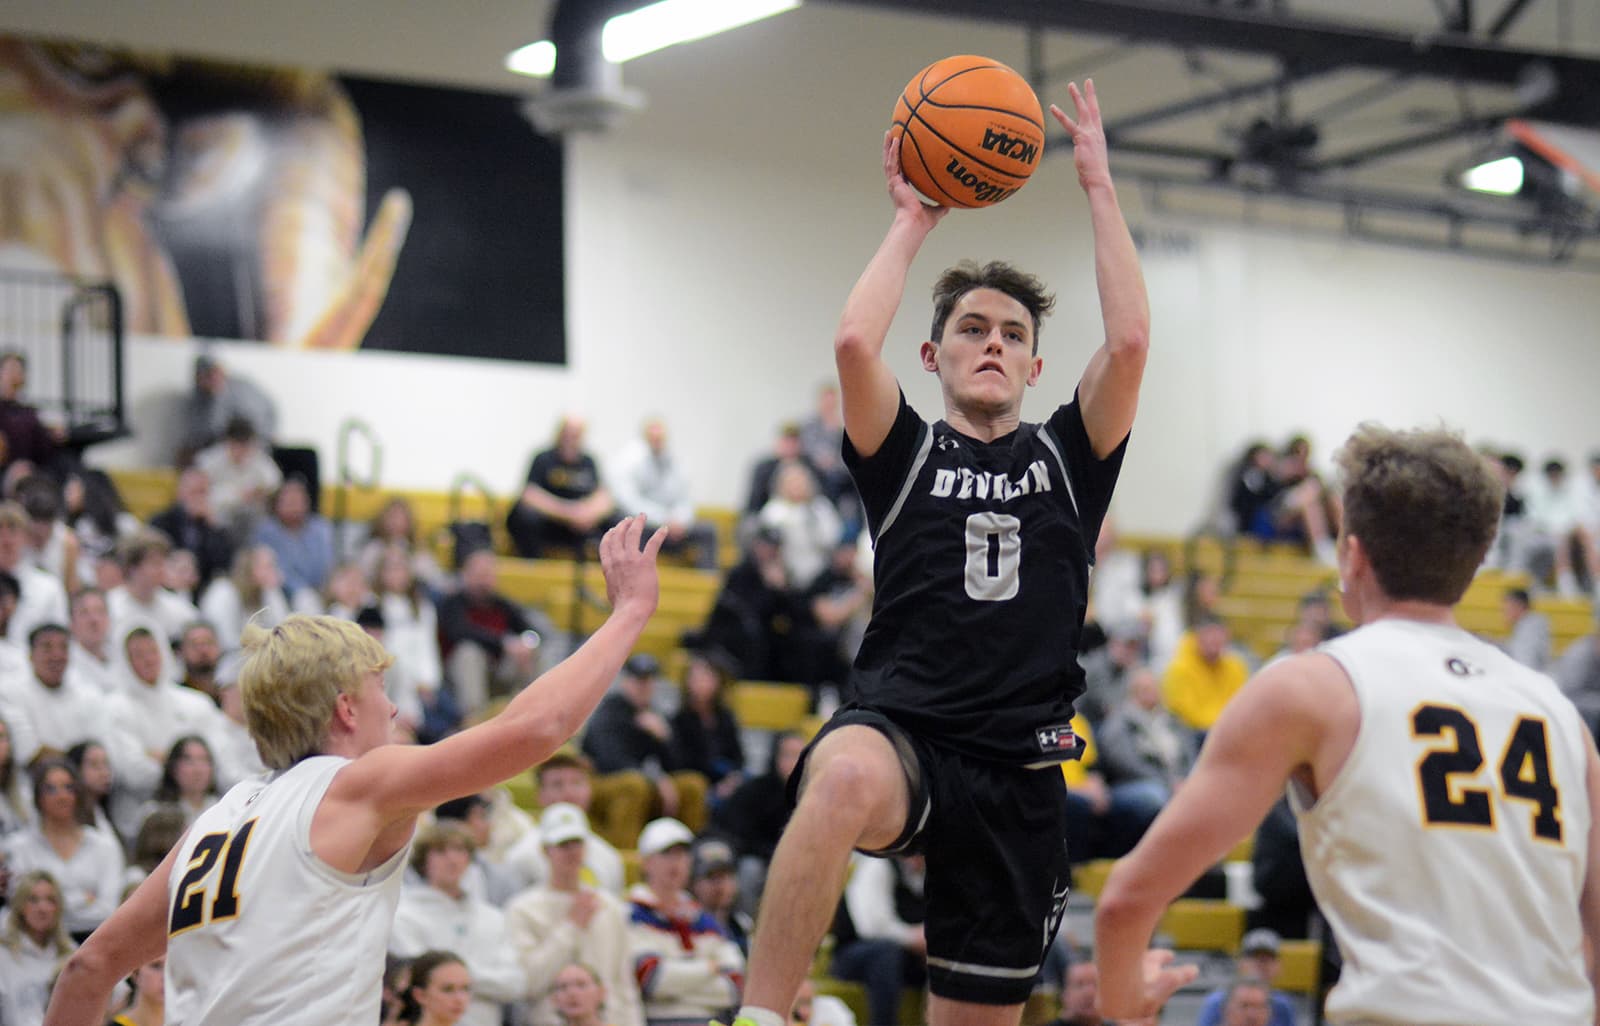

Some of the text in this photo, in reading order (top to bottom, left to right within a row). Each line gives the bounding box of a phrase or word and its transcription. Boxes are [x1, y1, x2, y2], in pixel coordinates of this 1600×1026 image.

[946, 158, 1022, 201] ilson
[982, 128, 1038, 165] NCAA
[964, 511, 1021, 601] 0
[1408, 701, 1565, 847] 24
[168, 816, 260, 938] 21
